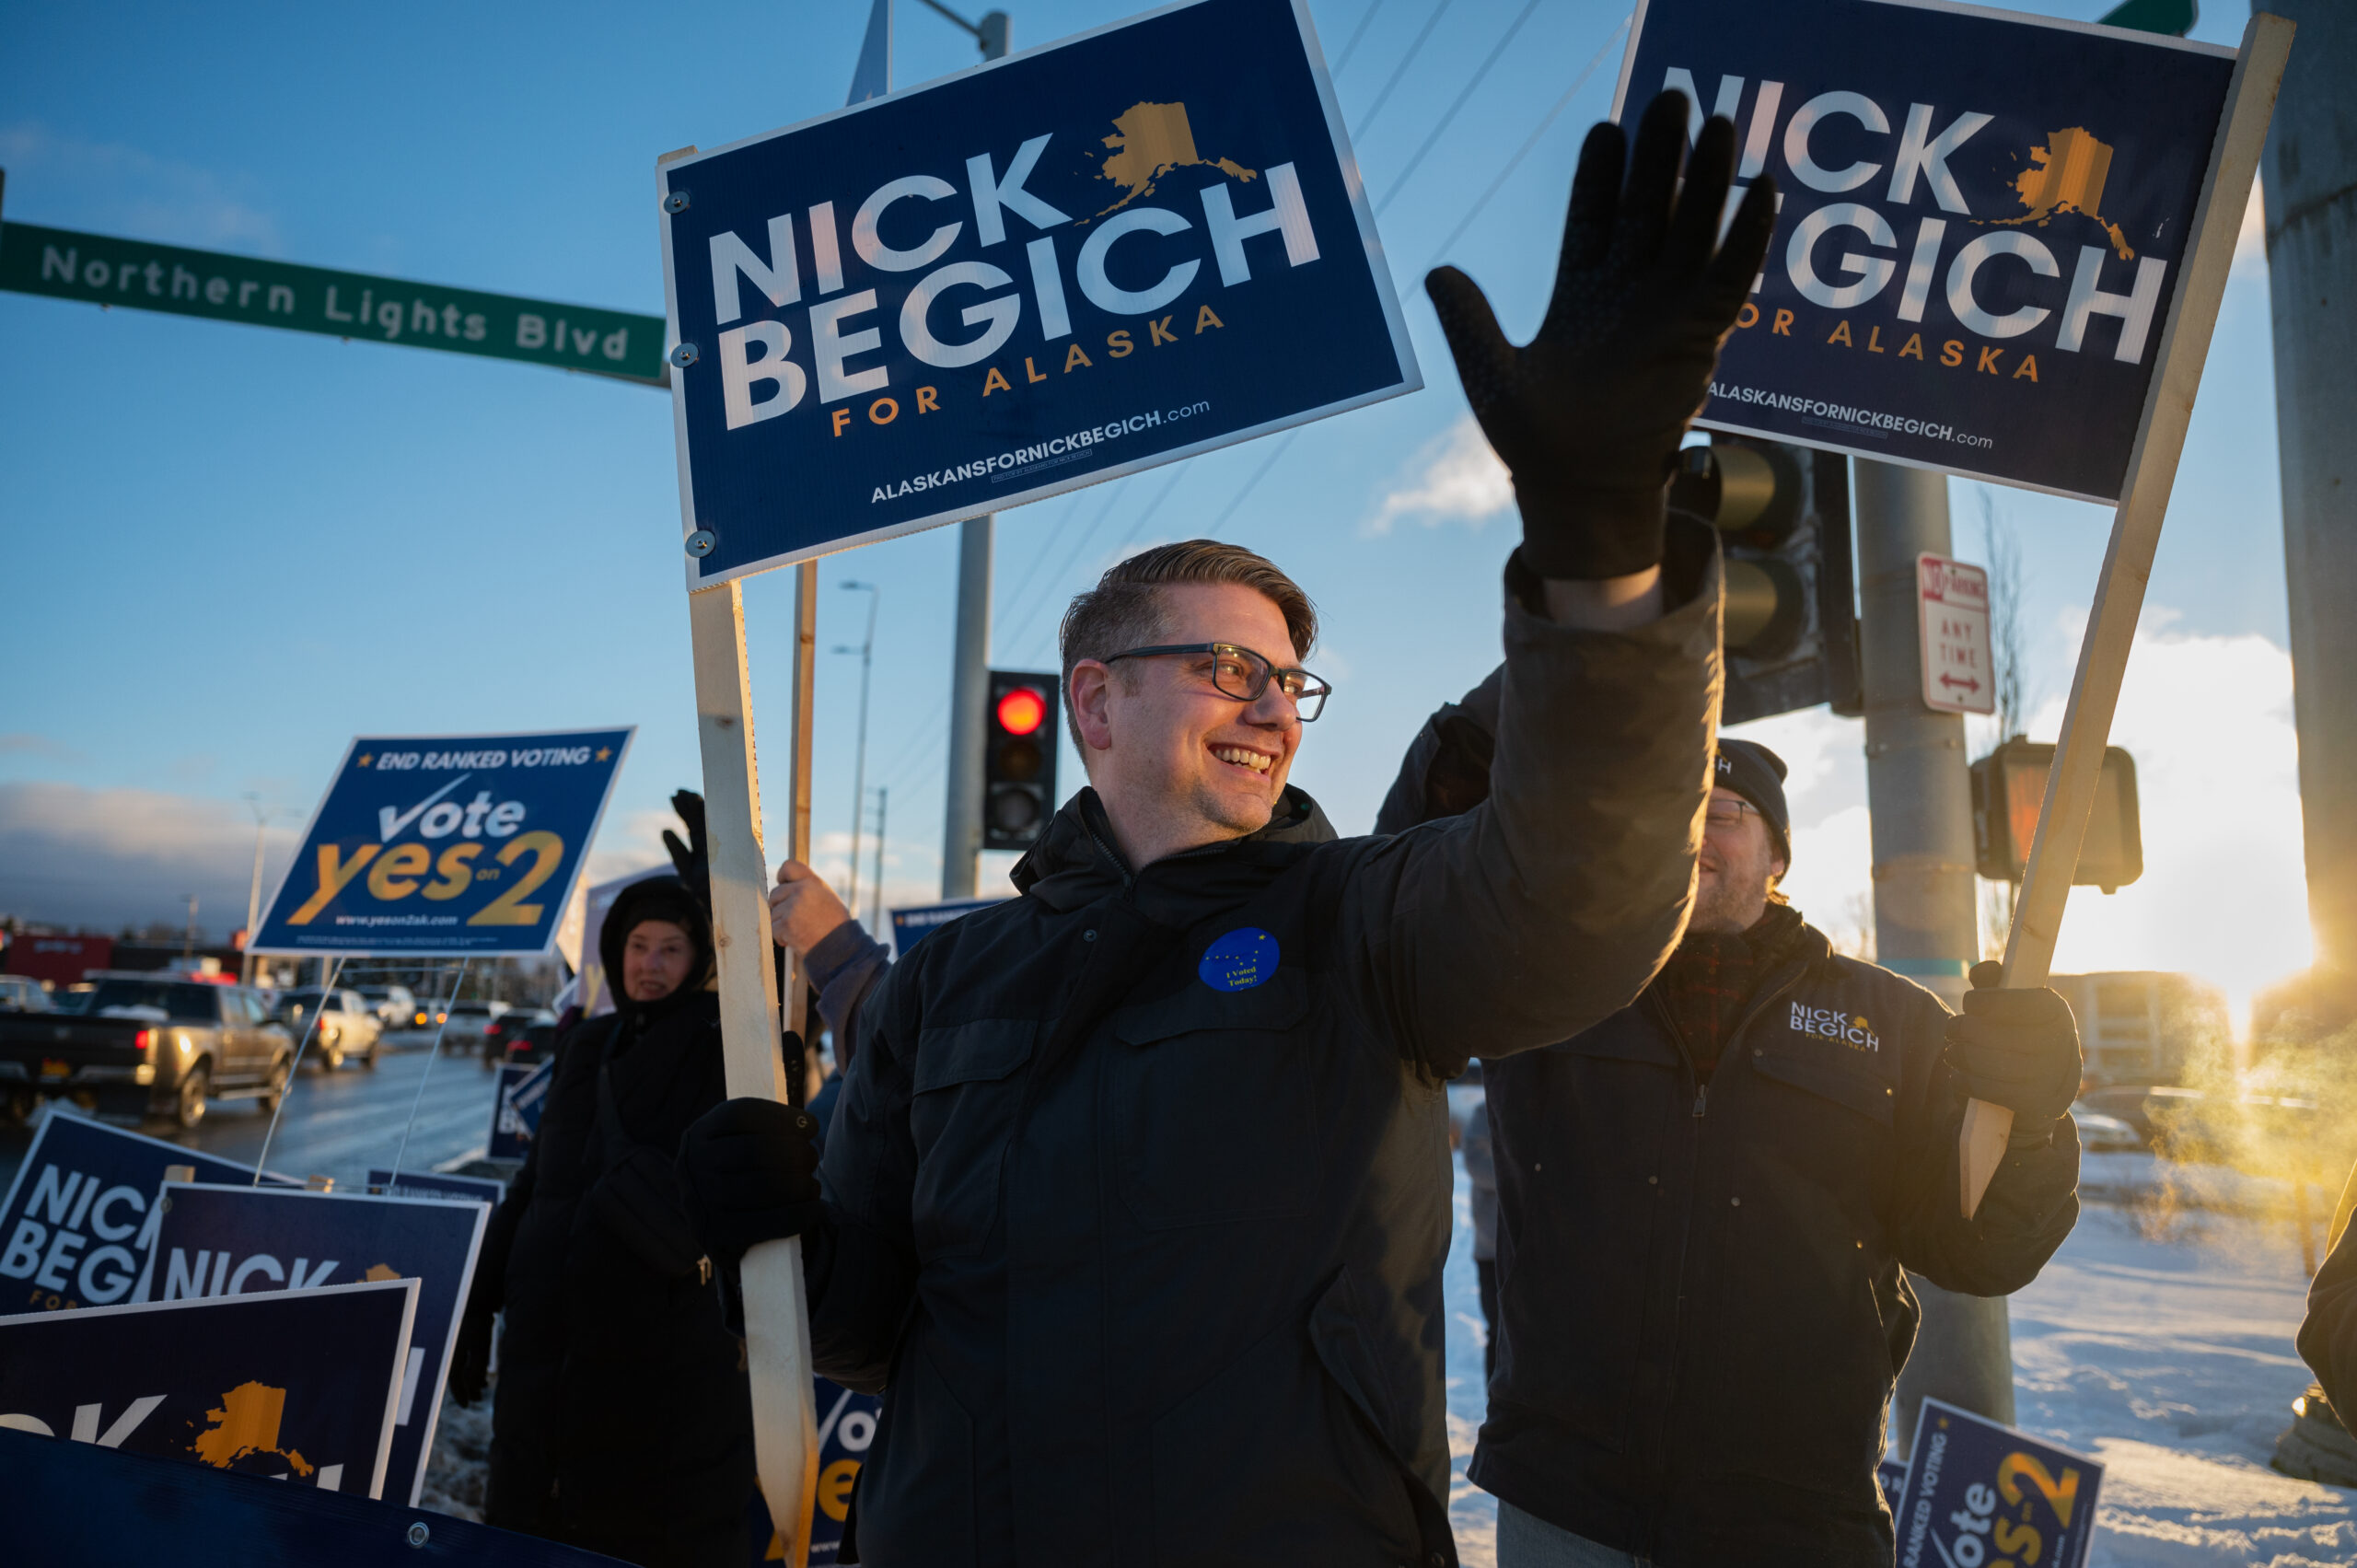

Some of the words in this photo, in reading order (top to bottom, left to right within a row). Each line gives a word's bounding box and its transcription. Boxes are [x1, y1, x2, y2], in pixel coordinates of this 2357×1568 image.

[709, 133, 1073, 324] NICK
[41, 246, 296, 314] Northern
[325, 286, 487, 342] Lights
[516, 313, 630, 361] Blvd
[718, 161, 1321, 430] BEGICH
[1713, 184, 2167, 365] GICH
[831, 386, 941, 437] FOR
[982, 304, 1225, 397] ALASKA
[1735, 302, 1794, 337] OR
[1828, 319, 2039, 382] ALASKA
[870, 398, 1211, 504] ALASKANSFORNICKBEGICH.com
[1706, 381, 1993, 449] ALASKANSFORNICKBEGICH.com
[1941, 619, 1972, 640] ANY
[376, 751, 422, 771] END
[421, 749, 507, 770] RANKED
[511, 746, 592, 768] VOTING
[285, 842, 485, 926] yes
[466, 830, 564, 926] 2
[476, 868, 501, 881] on
[1227, 974, 1258, 987] Today!
[1232, 966, 1257, 977] Voted
[1790, 1015, 1879, 1052] BEGICH
[1791, 1001, 1848, 1026] NICK
[1805, 1032, 1825, 1040] FOR
[1828, 1037, 1866, 1052] ALASKA
[1996, 1452, 2080, 1529] 2
